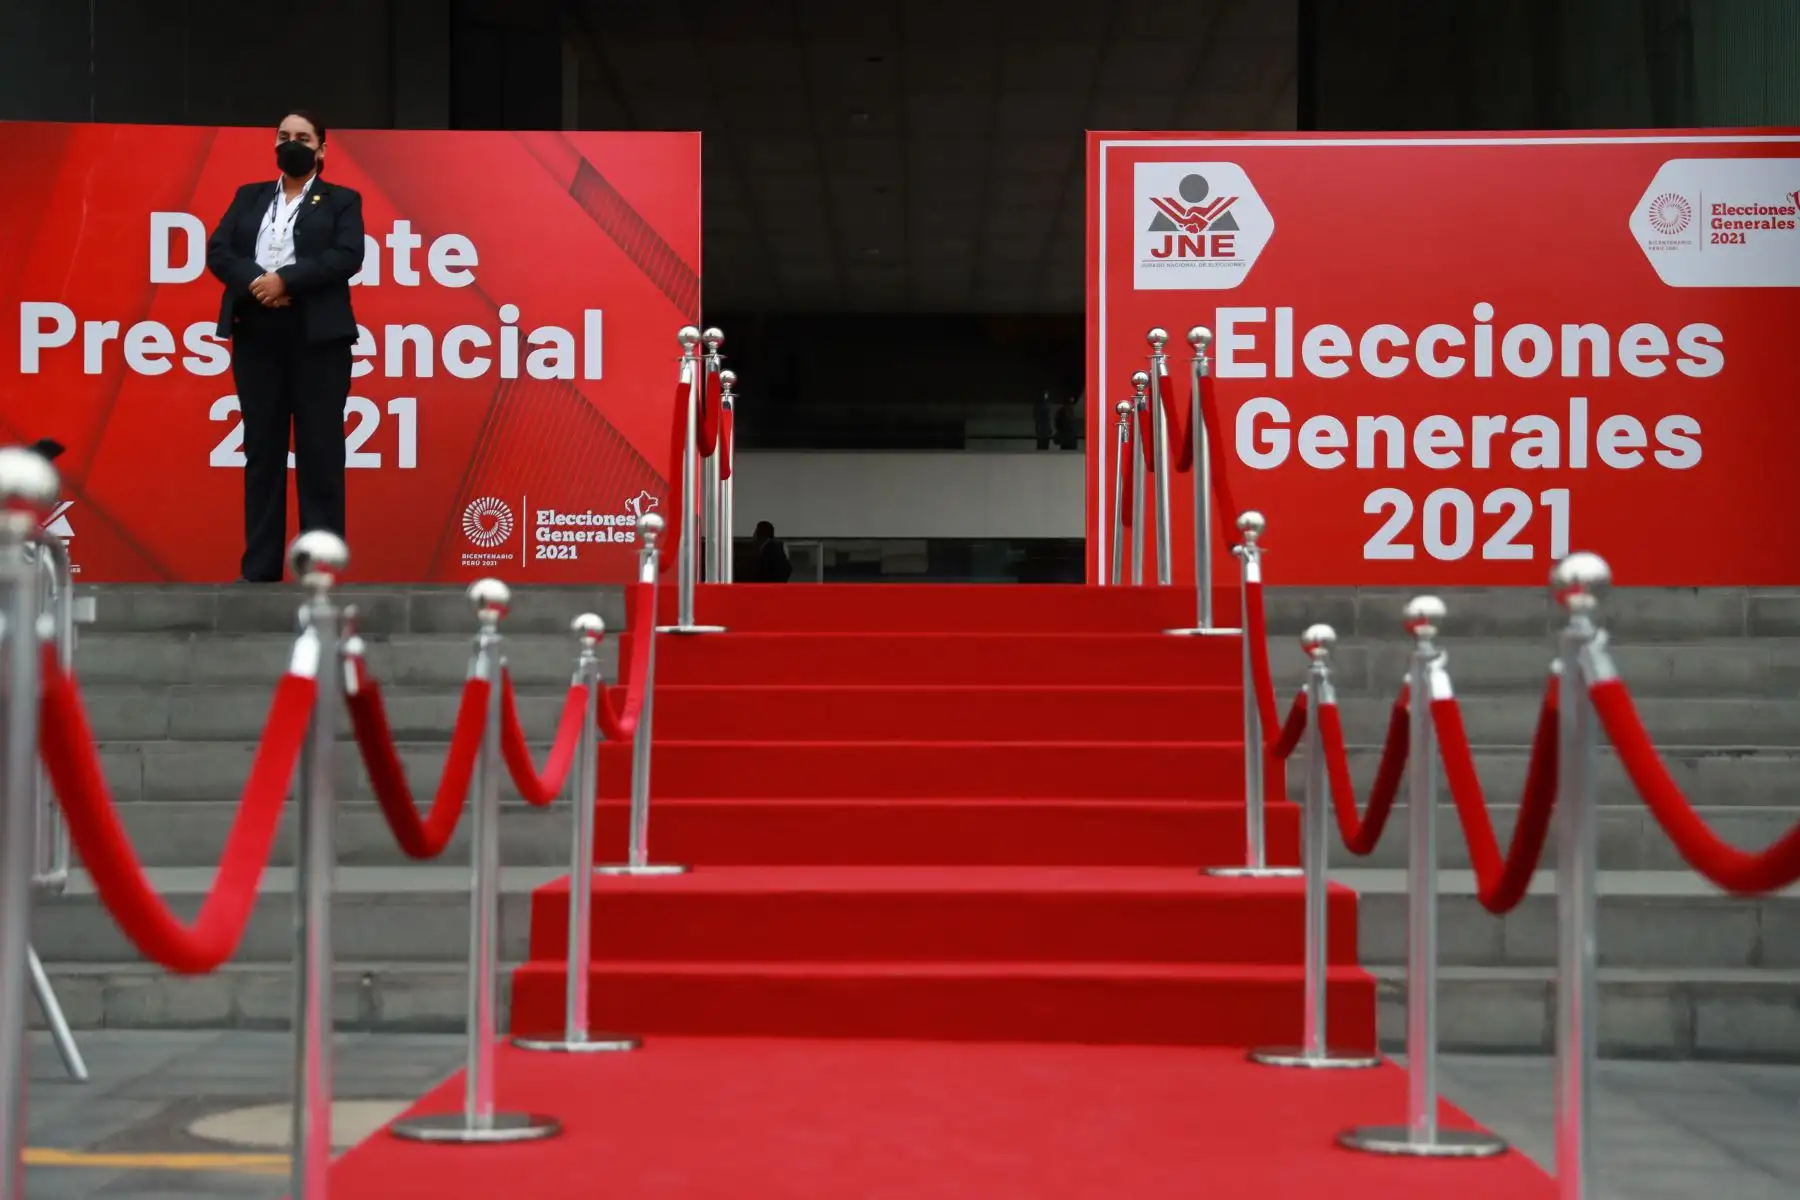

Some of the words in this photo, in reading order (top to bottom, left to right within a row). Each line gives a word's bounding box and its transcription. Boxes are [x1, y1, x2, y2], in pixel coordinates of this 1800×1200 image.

[1710, 203, 1795, 216] Elecciones
[1710, 217, 1795, 230] Generales
[1150, 234, 1236, 258] JNE
[1710, 232, 1746, 244] 2021
[1215, 301, 1725, 379] Elecciones
[208, 394, 417, 469] 221
[1235, 396, 1702, 470] Generales
[536, 510, 636, 526] Elecciones
[1363, 487, 1569, 561] 2021
[535, 527, 635, 543] Generales
[535, 545, 578, 560] 2021
